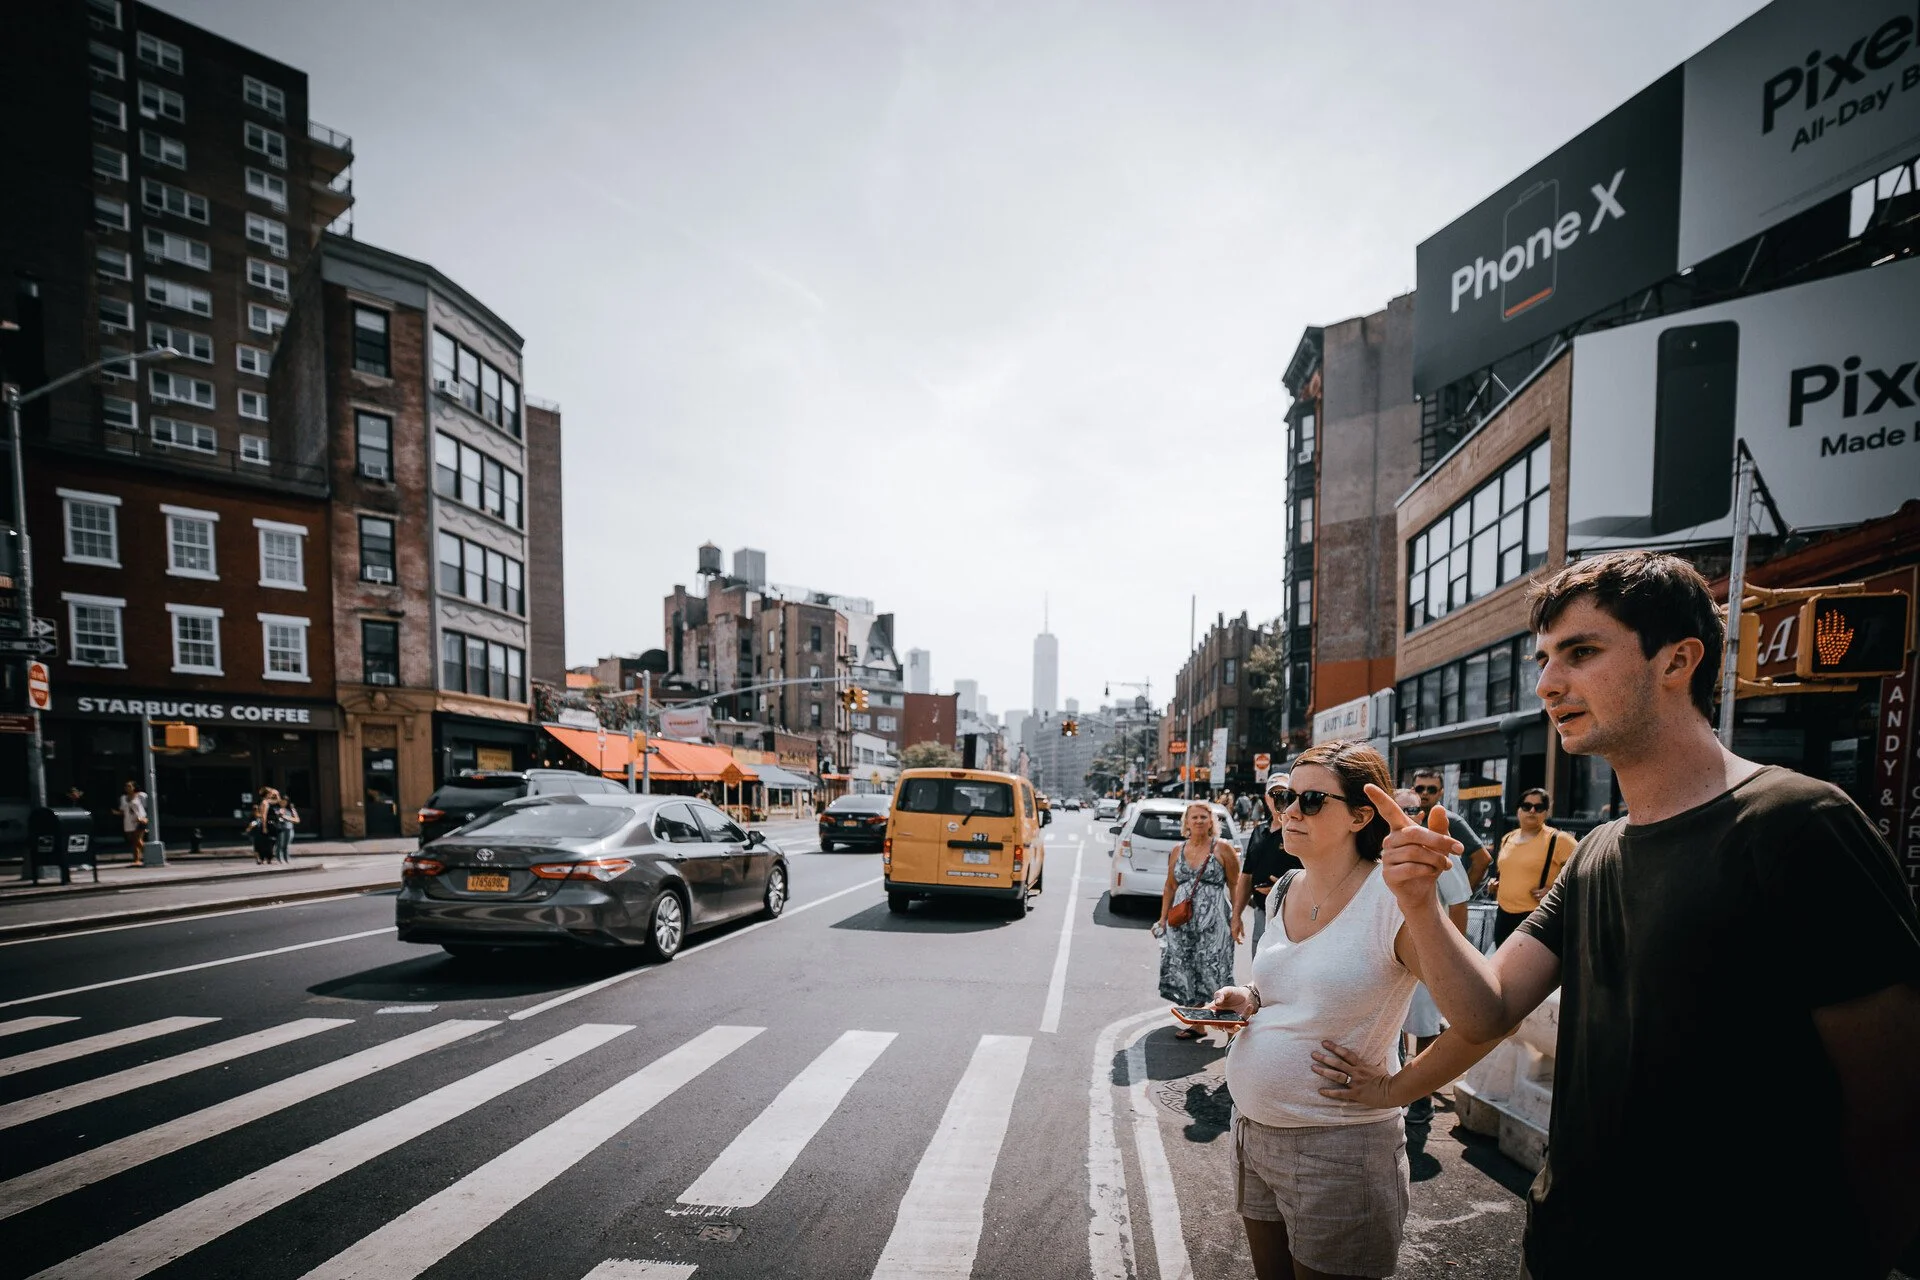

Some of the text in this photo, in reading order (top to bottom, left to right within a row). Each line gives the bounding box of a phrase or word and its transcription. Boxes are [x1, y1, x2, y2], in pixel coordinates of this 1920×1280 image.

[1791, 81, 1894, 153] All-Day
[1451, 167, 1627, 313] Phone X
[1789, 355, 1920, 428] Pix
[1821, 426, 1906, 457] Made
[77, 697, 310, 723] STARBUCKS COFFEE
[1883, 671, 1906, 776] ANDY
[1879, 787, 1894, 807] &
